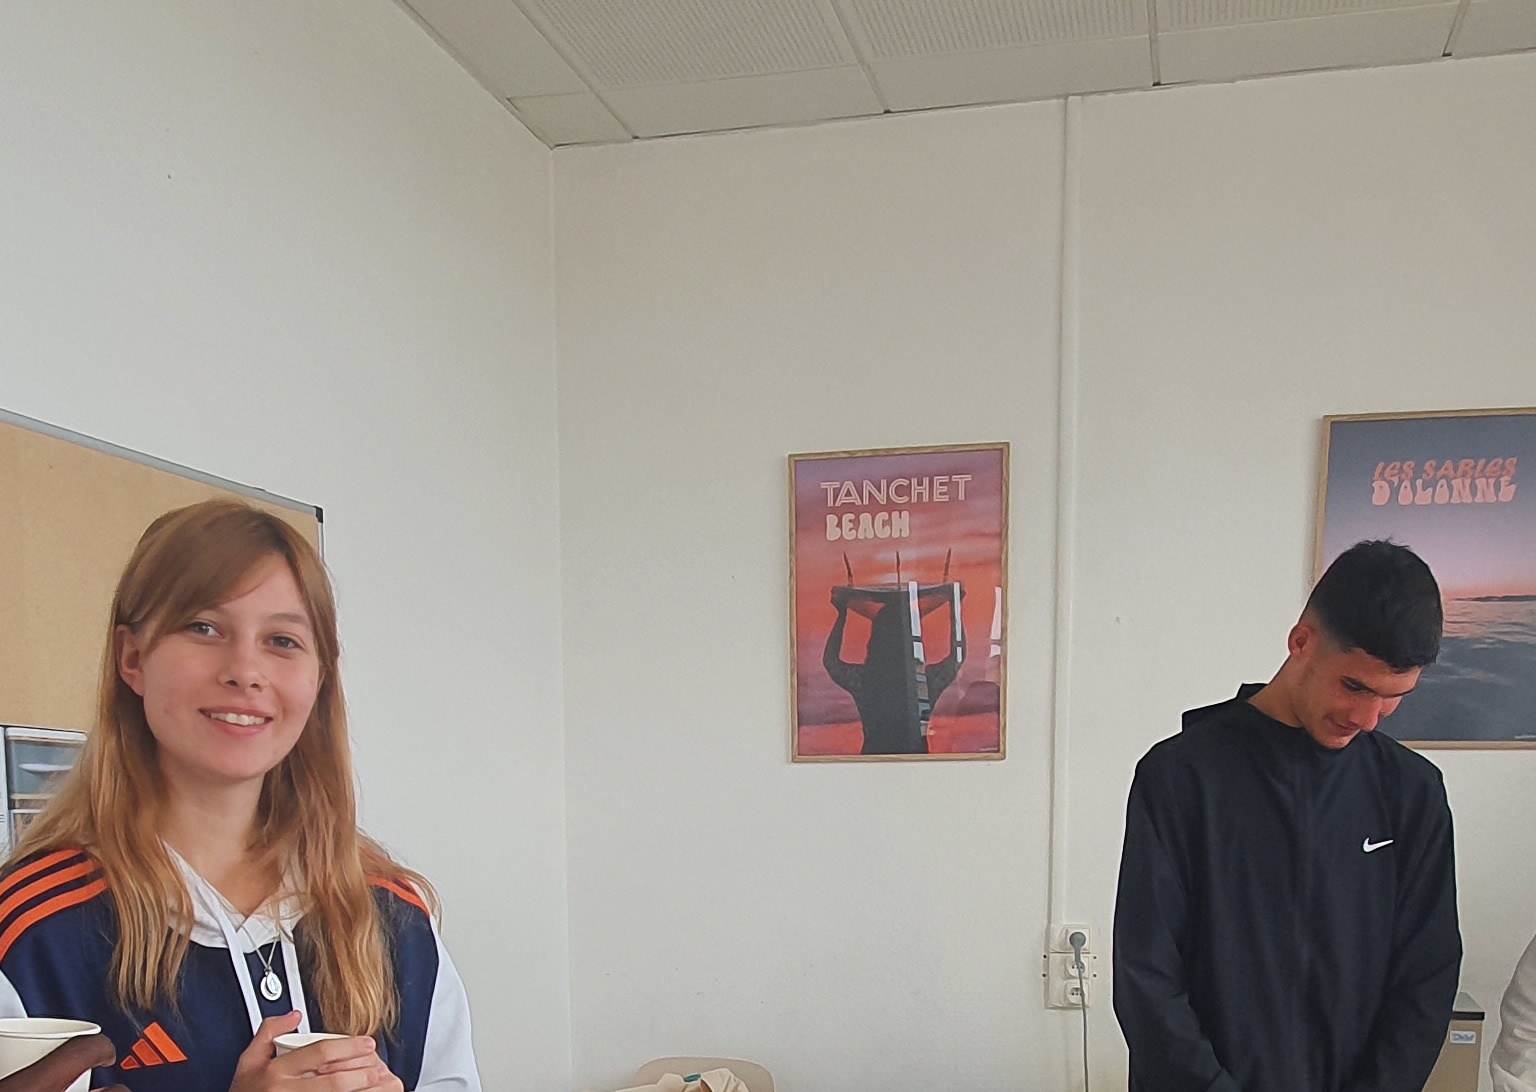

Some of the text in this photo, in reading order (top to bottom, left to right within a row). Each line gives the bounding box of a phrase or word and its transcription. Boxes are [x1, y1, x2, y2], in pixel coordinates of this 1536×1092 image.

[1373, 457, 1517, 482] LES SABLES
[820, 474, 972, 507] TANCHET
[1372, 475, 1517, 506] D'OLONNE
[825, 510, 910, 541] BEACH
